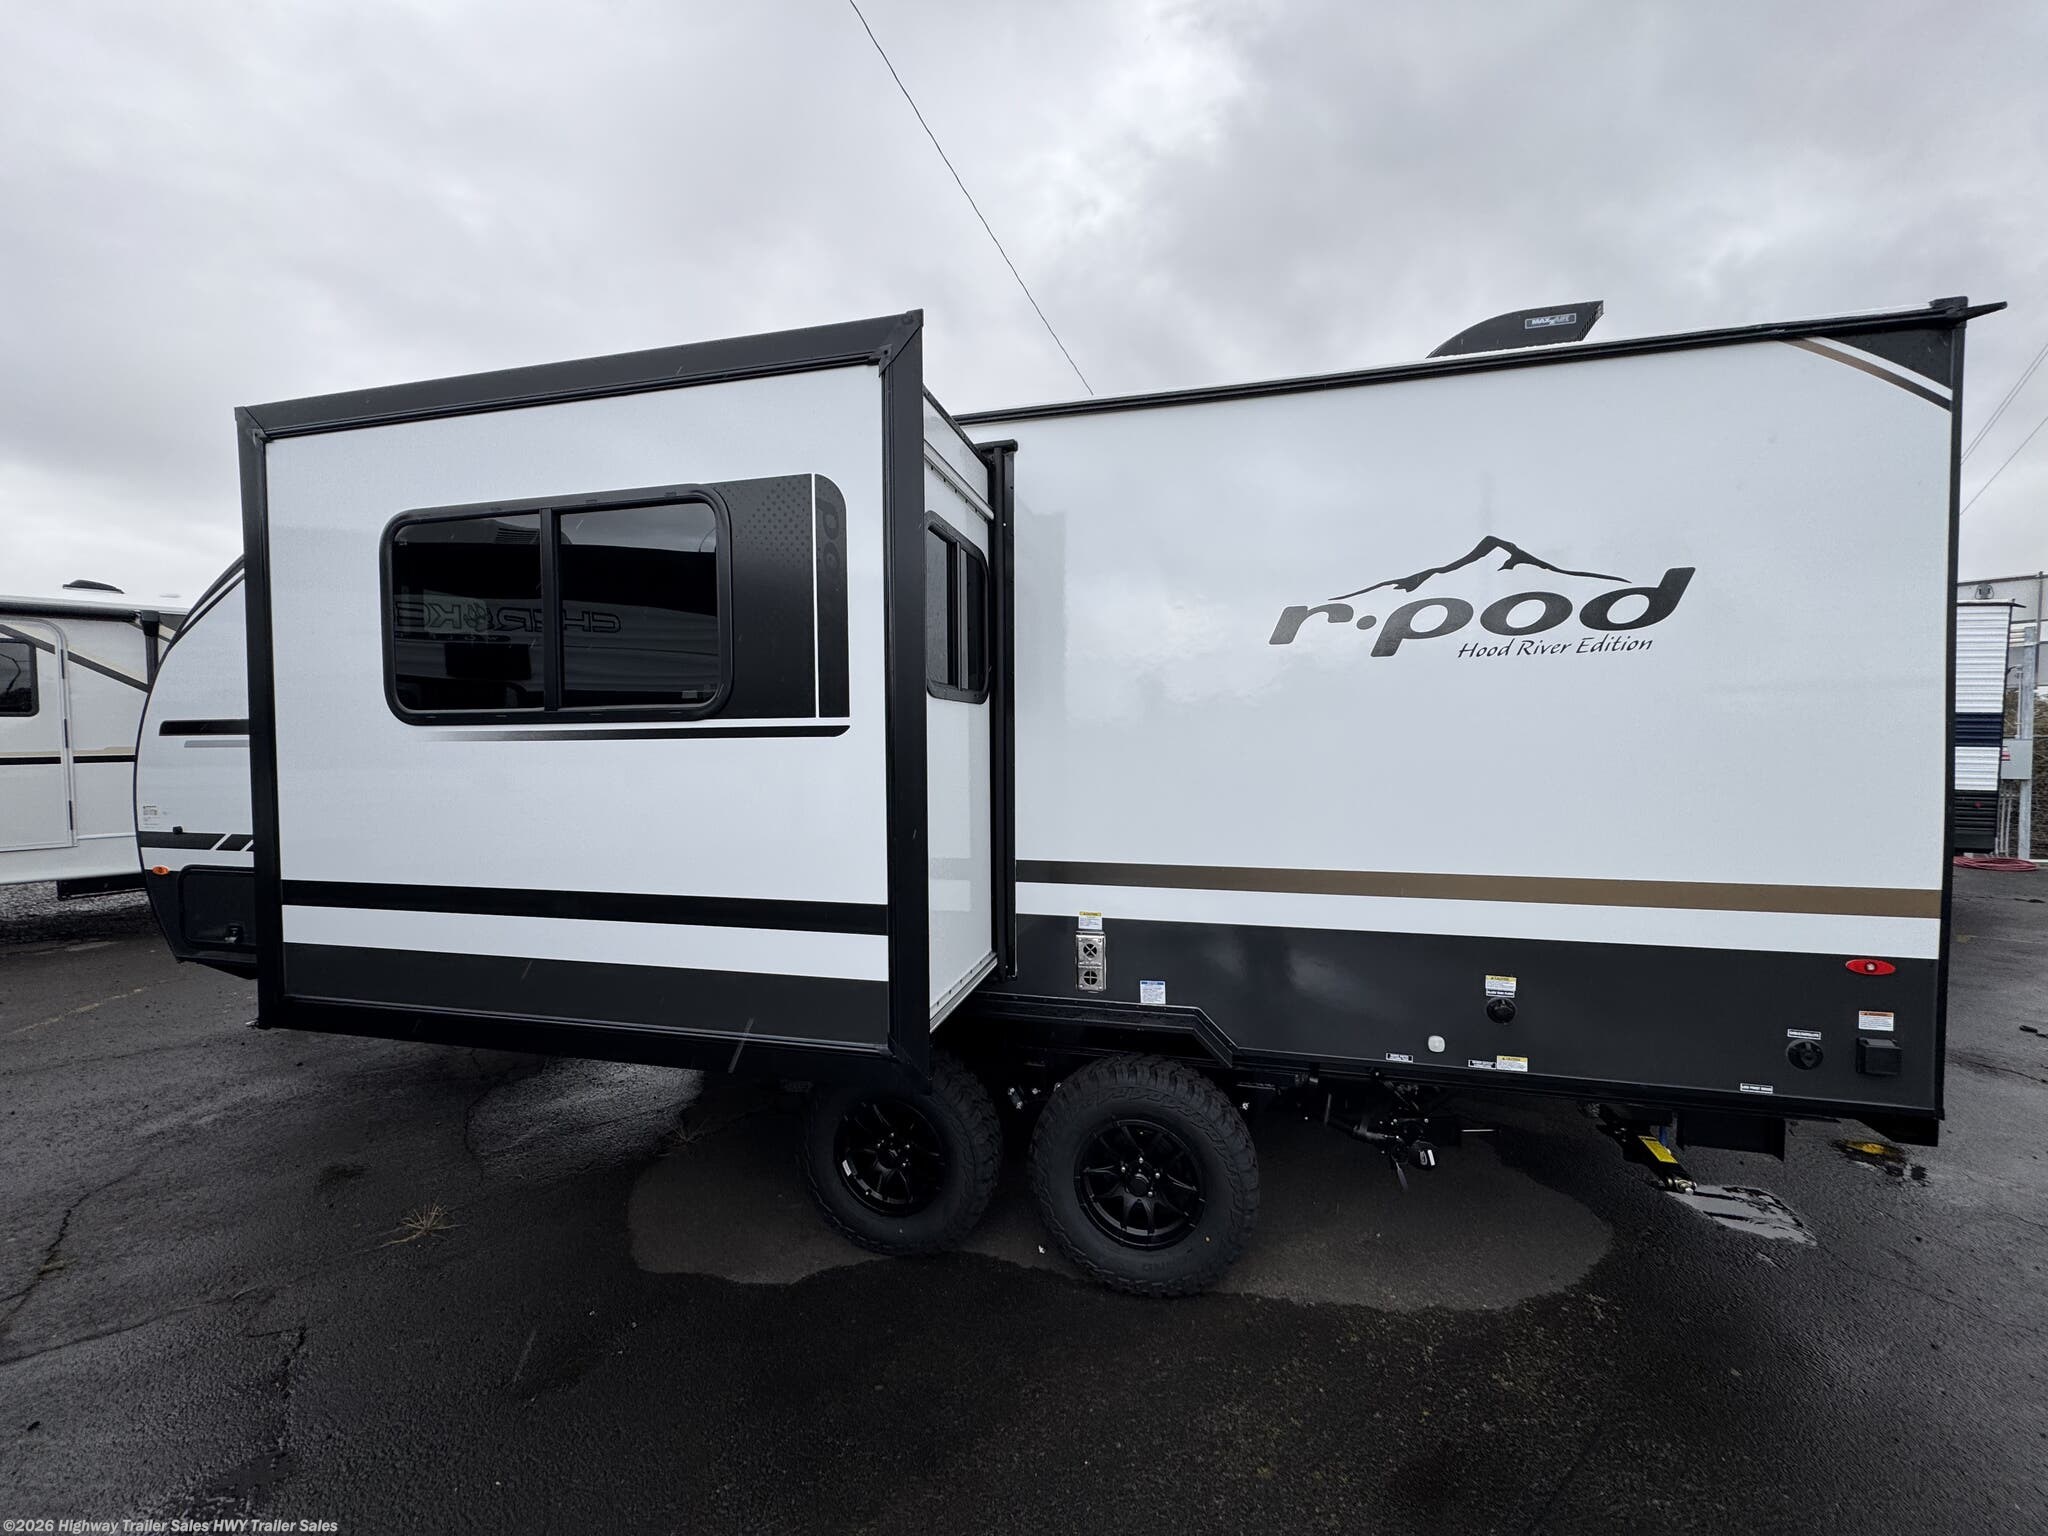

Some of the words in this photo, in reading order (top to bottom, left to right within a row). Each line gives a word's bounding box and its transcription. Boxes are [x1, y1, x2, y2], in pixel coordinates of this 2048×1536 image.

[1457, 638, 1515, 659] Hood
[1516, 640, 1572, 656] River
[1575, 633, 1653, 654] Edition
